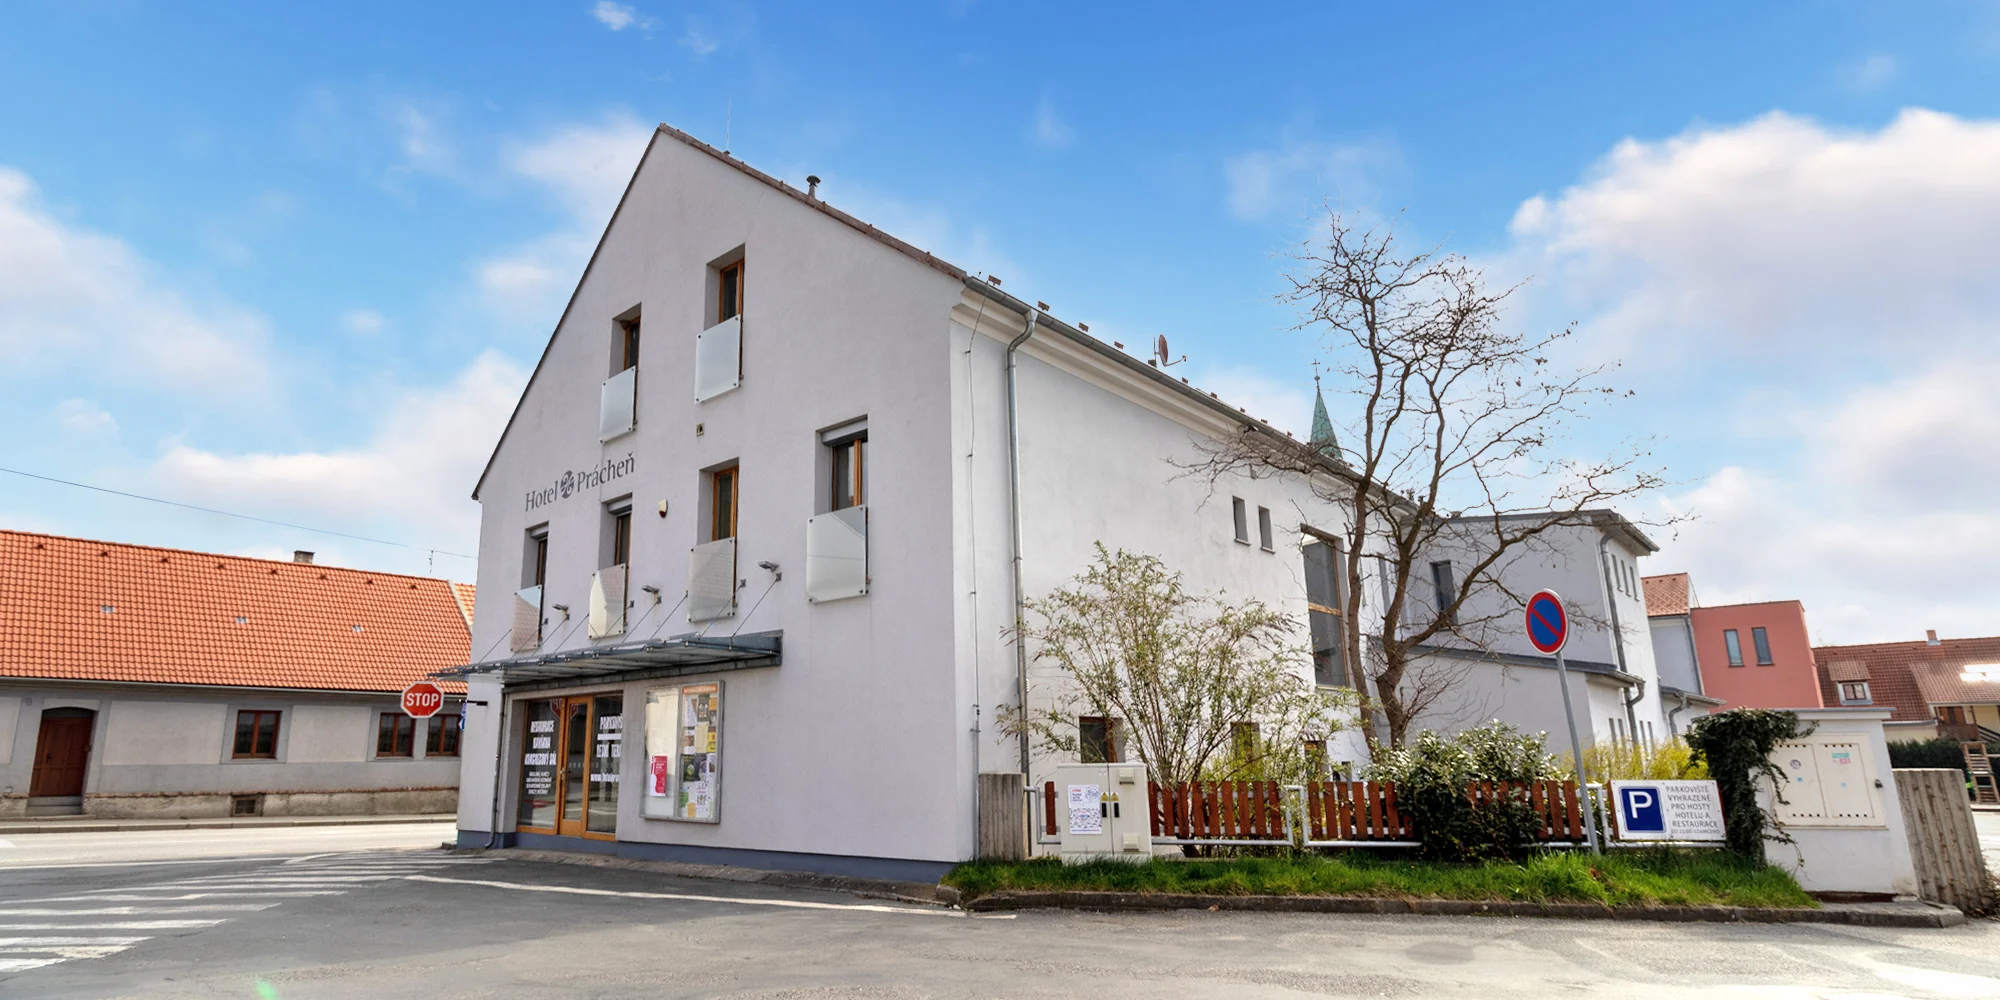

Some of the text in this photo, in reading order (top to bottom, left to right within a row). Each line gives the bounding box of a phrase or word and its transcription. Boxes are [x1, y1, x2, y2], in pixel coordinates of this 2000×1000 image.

[525, 451, 635, 512] Hotel Prácheň
[406, 692, 439, 707] STOP
[1665, 785, 1709, 793] PARKOVIŠTĚ
[1628, 791, 1652, 819] P
[1675, 811, 1704, 819] HOTELU
[1672, 820, 1718, 828] RESTAURACE
